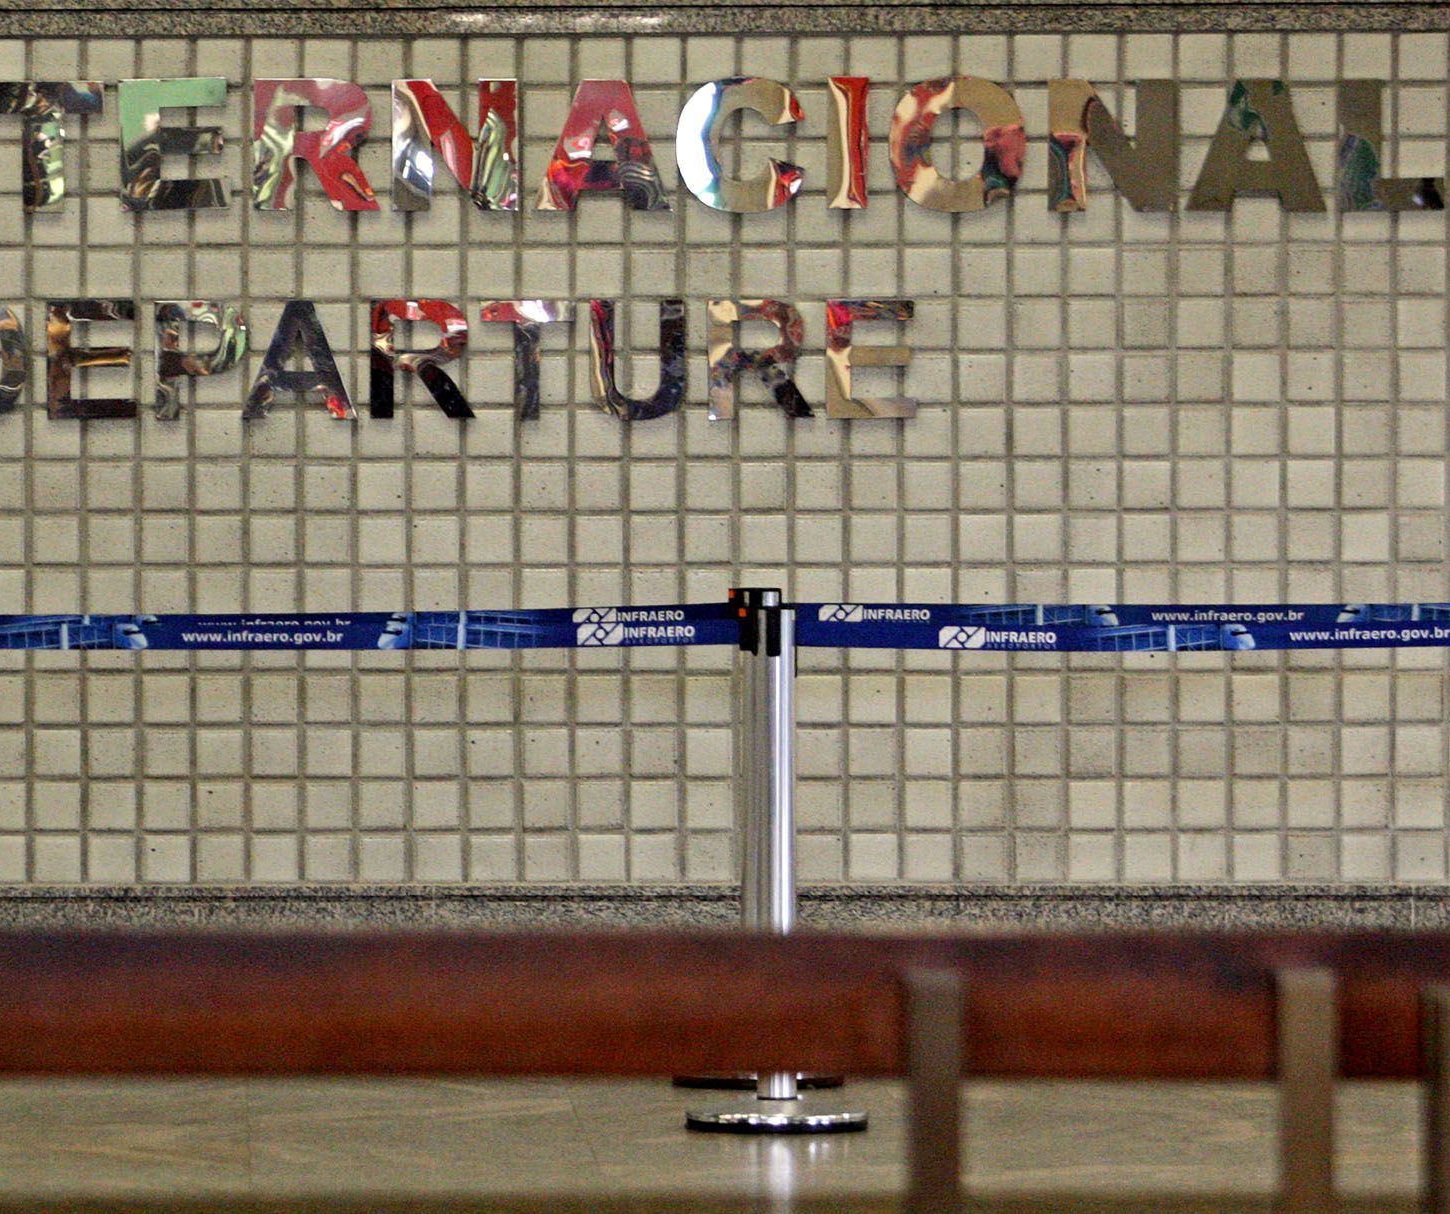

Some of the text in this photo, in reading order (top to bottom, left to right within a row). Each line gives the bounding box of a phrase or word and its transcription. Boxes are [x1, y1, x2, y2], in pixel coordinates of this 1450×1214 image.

[618, 610, 684, 622] INFRAERO
[863, 609, 931, 620] INFRAERO
[1151, 609, 1304, 623] www.infraero.gov.br
[181, 630, 344, 644] www.infraero.gov.br
[625, 625, 695, 638] INFRAERO
[986, 632, 1057, 643] INFRAERO
[1289, 625, 1450, 641] www.infraero.gov.br
